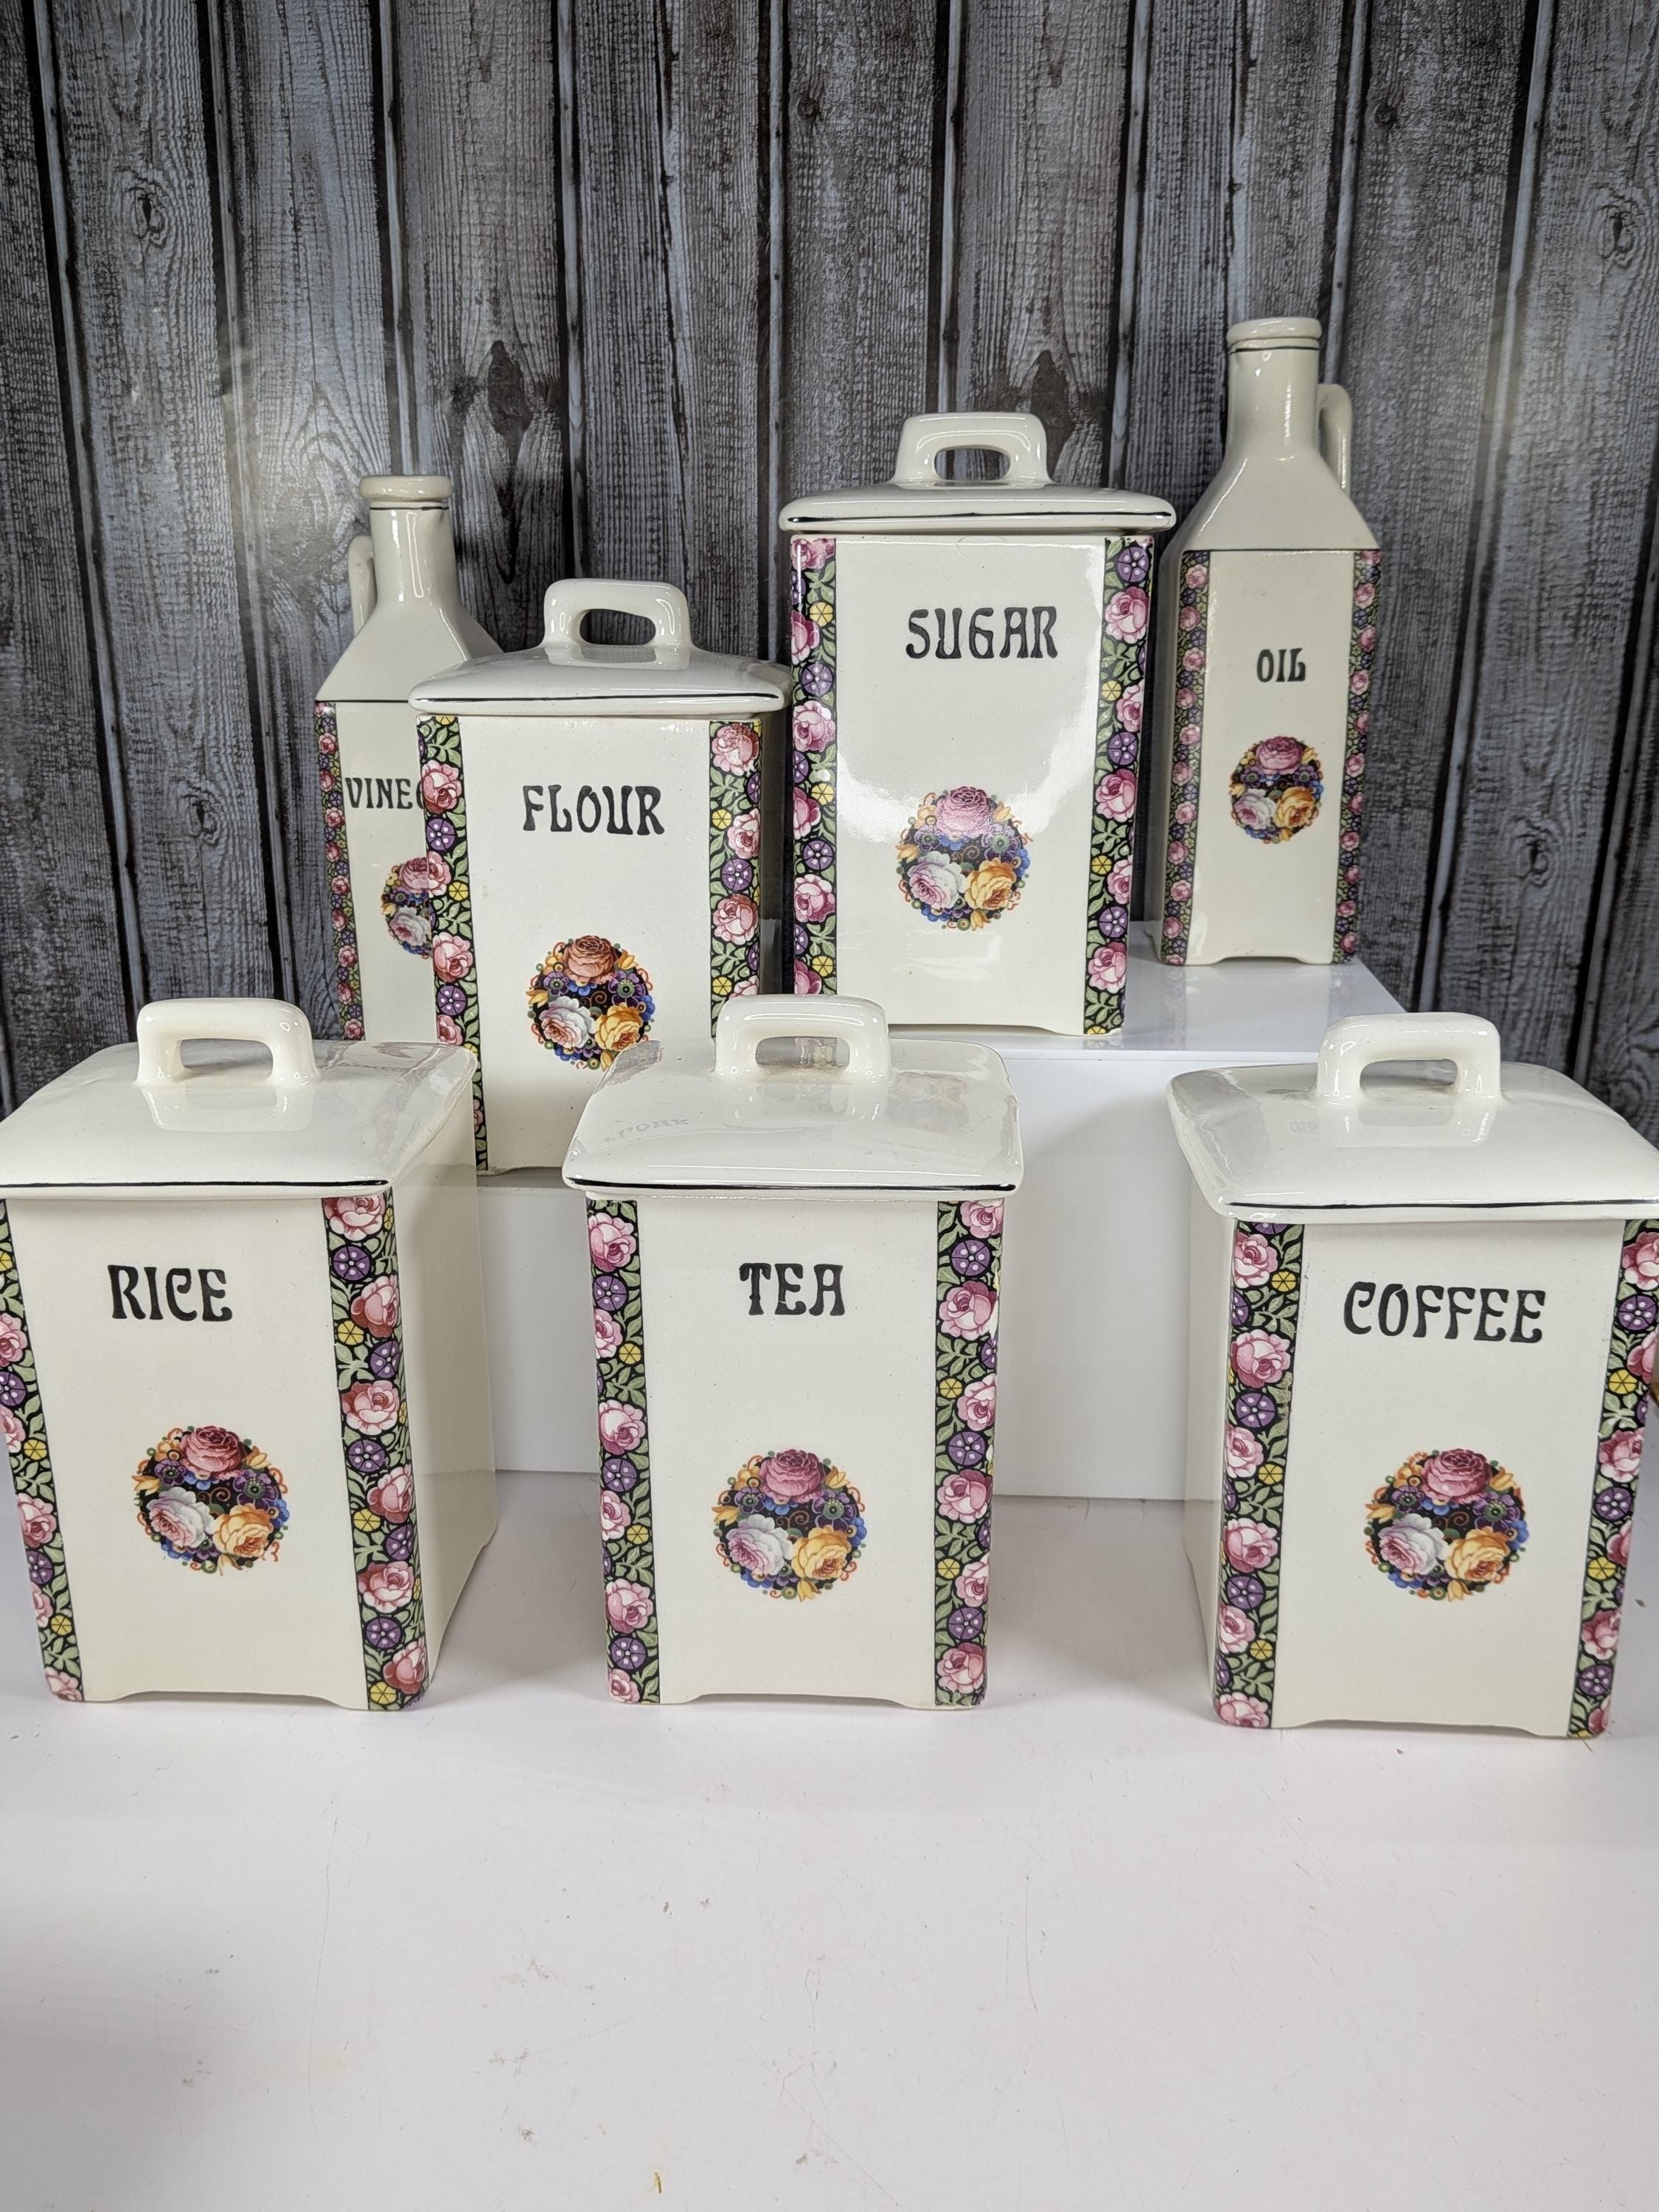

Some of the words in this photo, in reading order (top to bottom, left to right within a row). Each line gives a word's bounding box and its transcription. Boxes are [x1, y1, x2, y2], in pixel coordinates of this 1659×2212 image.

[905, 606, 1058, 660] SUGAR
[1256, 647, 1306, 683] OIL
[344, 777, 423, 810] VINE
[523, 784, 665, 836] FLOUR
[108, 1265, 232, 1321] RICE
[738, 1262, 845, 1316] TEA
[1343, 1281, 1546, 1343] COFFEE
